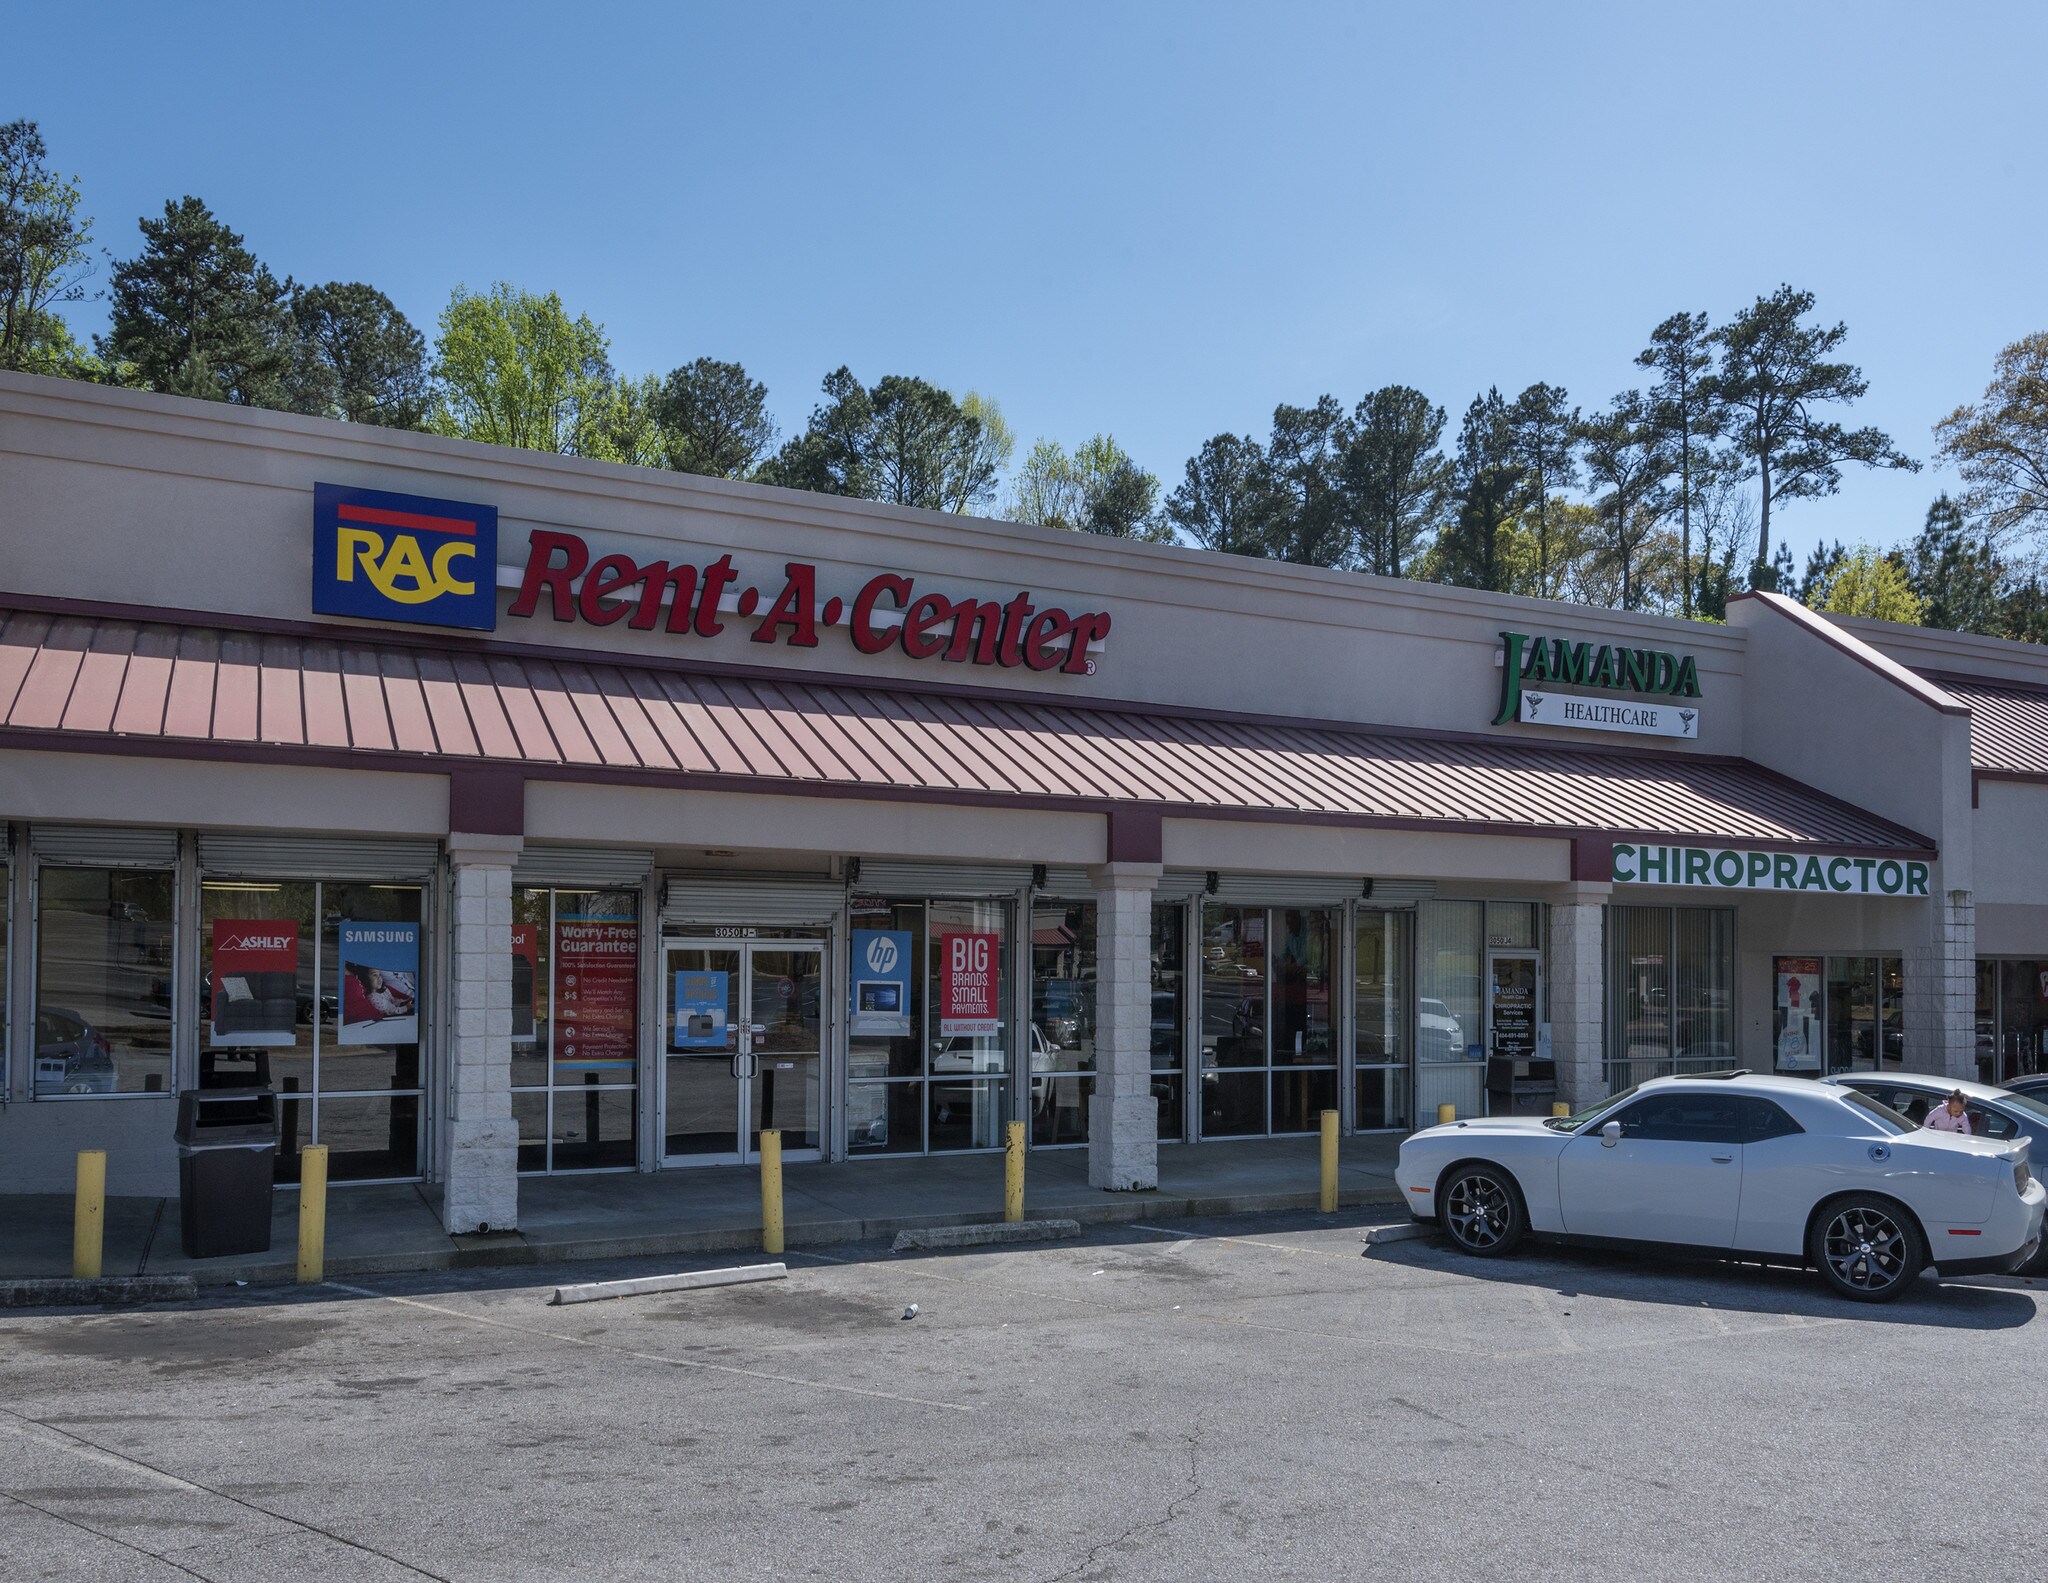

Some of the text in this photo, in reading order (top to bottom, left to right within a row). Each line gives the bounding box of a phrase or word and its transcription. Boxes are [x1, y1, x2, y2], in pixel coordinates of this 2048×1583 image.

[336, 526, 476, 604] RAC
[1491, 631, 1703, 727] JAMANDA
[1563, 702, 1658, 728] HEALTHCARE
[1612, 844, 1929, 896] CHIROPRACTOR
[345, 930, 414, 943] SAMSUNG
[561, 926, 637, 940] Worry-Free
[716, 927, 740, 937] 3050
[240, 936, 291, 949] ASHLEY
[561, 939, 637, 953] Guarantee
[952, 938, 988, 972] BIG
[952, 972, 989, 986] BRANDS.
[952, 987, 988, 1002] SMALL
[952, 1003, 989, 1014] PAYMENTS.
[944, 1023, 952, 1031] ALL
[953, 1023, 976, 1031] WITHOUT
